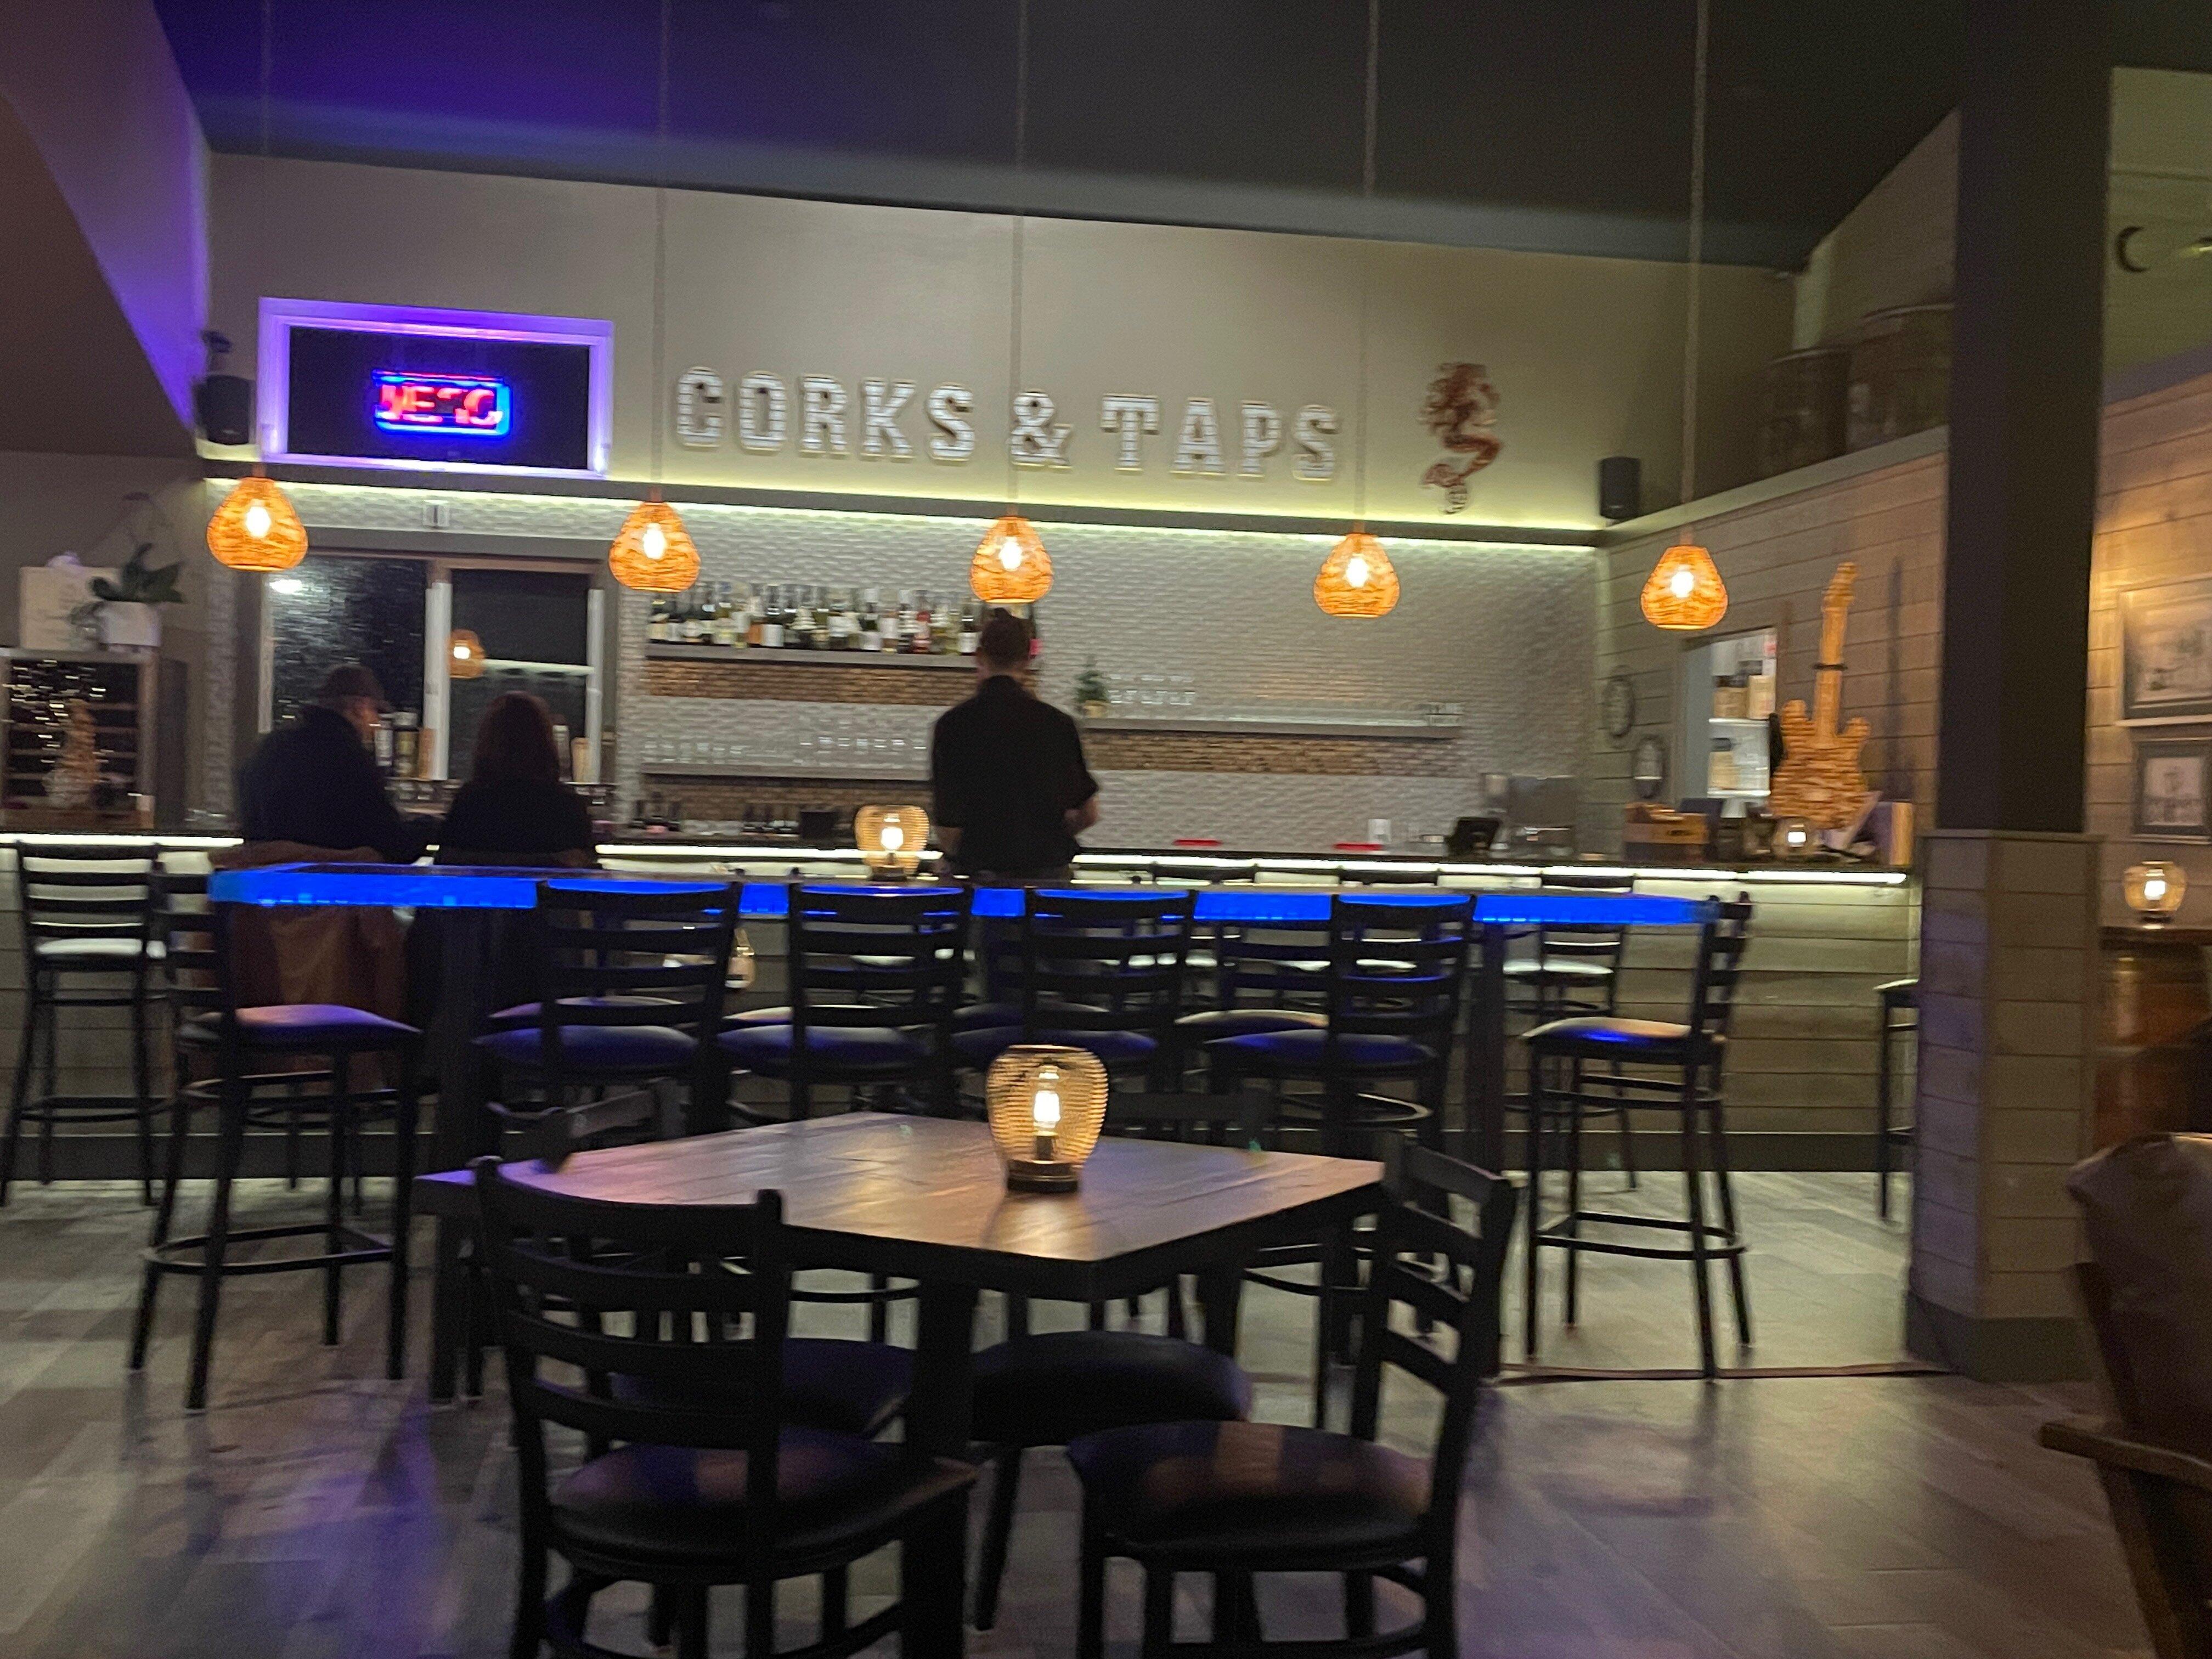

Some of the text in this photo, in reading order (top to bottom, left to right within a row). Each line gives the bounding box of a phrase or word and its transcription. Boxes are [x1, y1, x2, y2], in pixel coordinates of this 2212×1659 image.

[676, 366, 1339, 481] CORKS & TAPS
